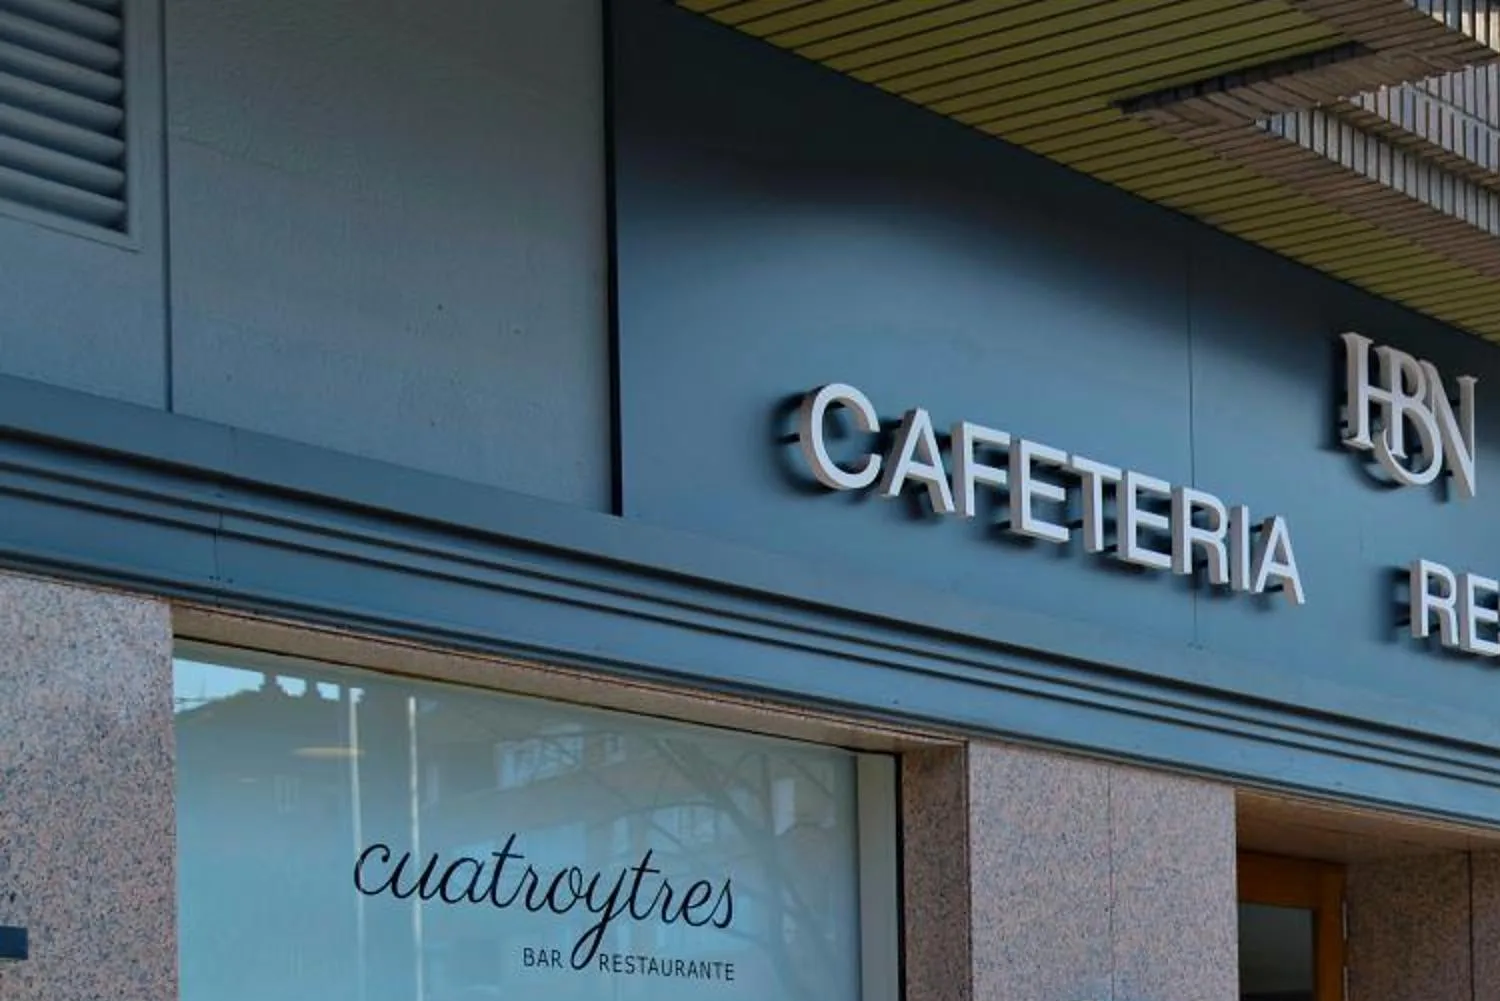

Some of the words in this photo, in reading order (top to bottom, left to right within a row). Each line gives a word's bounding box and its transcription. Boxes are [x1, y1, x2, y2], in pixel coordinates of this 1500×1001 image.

[799, 383, 1305, 605] CAFETERIA
[352, 832, 735, 971] cuatroytres
[522, 946, 563, 970] BAR
[599, 952, 736, 982] RESTAURANTE
